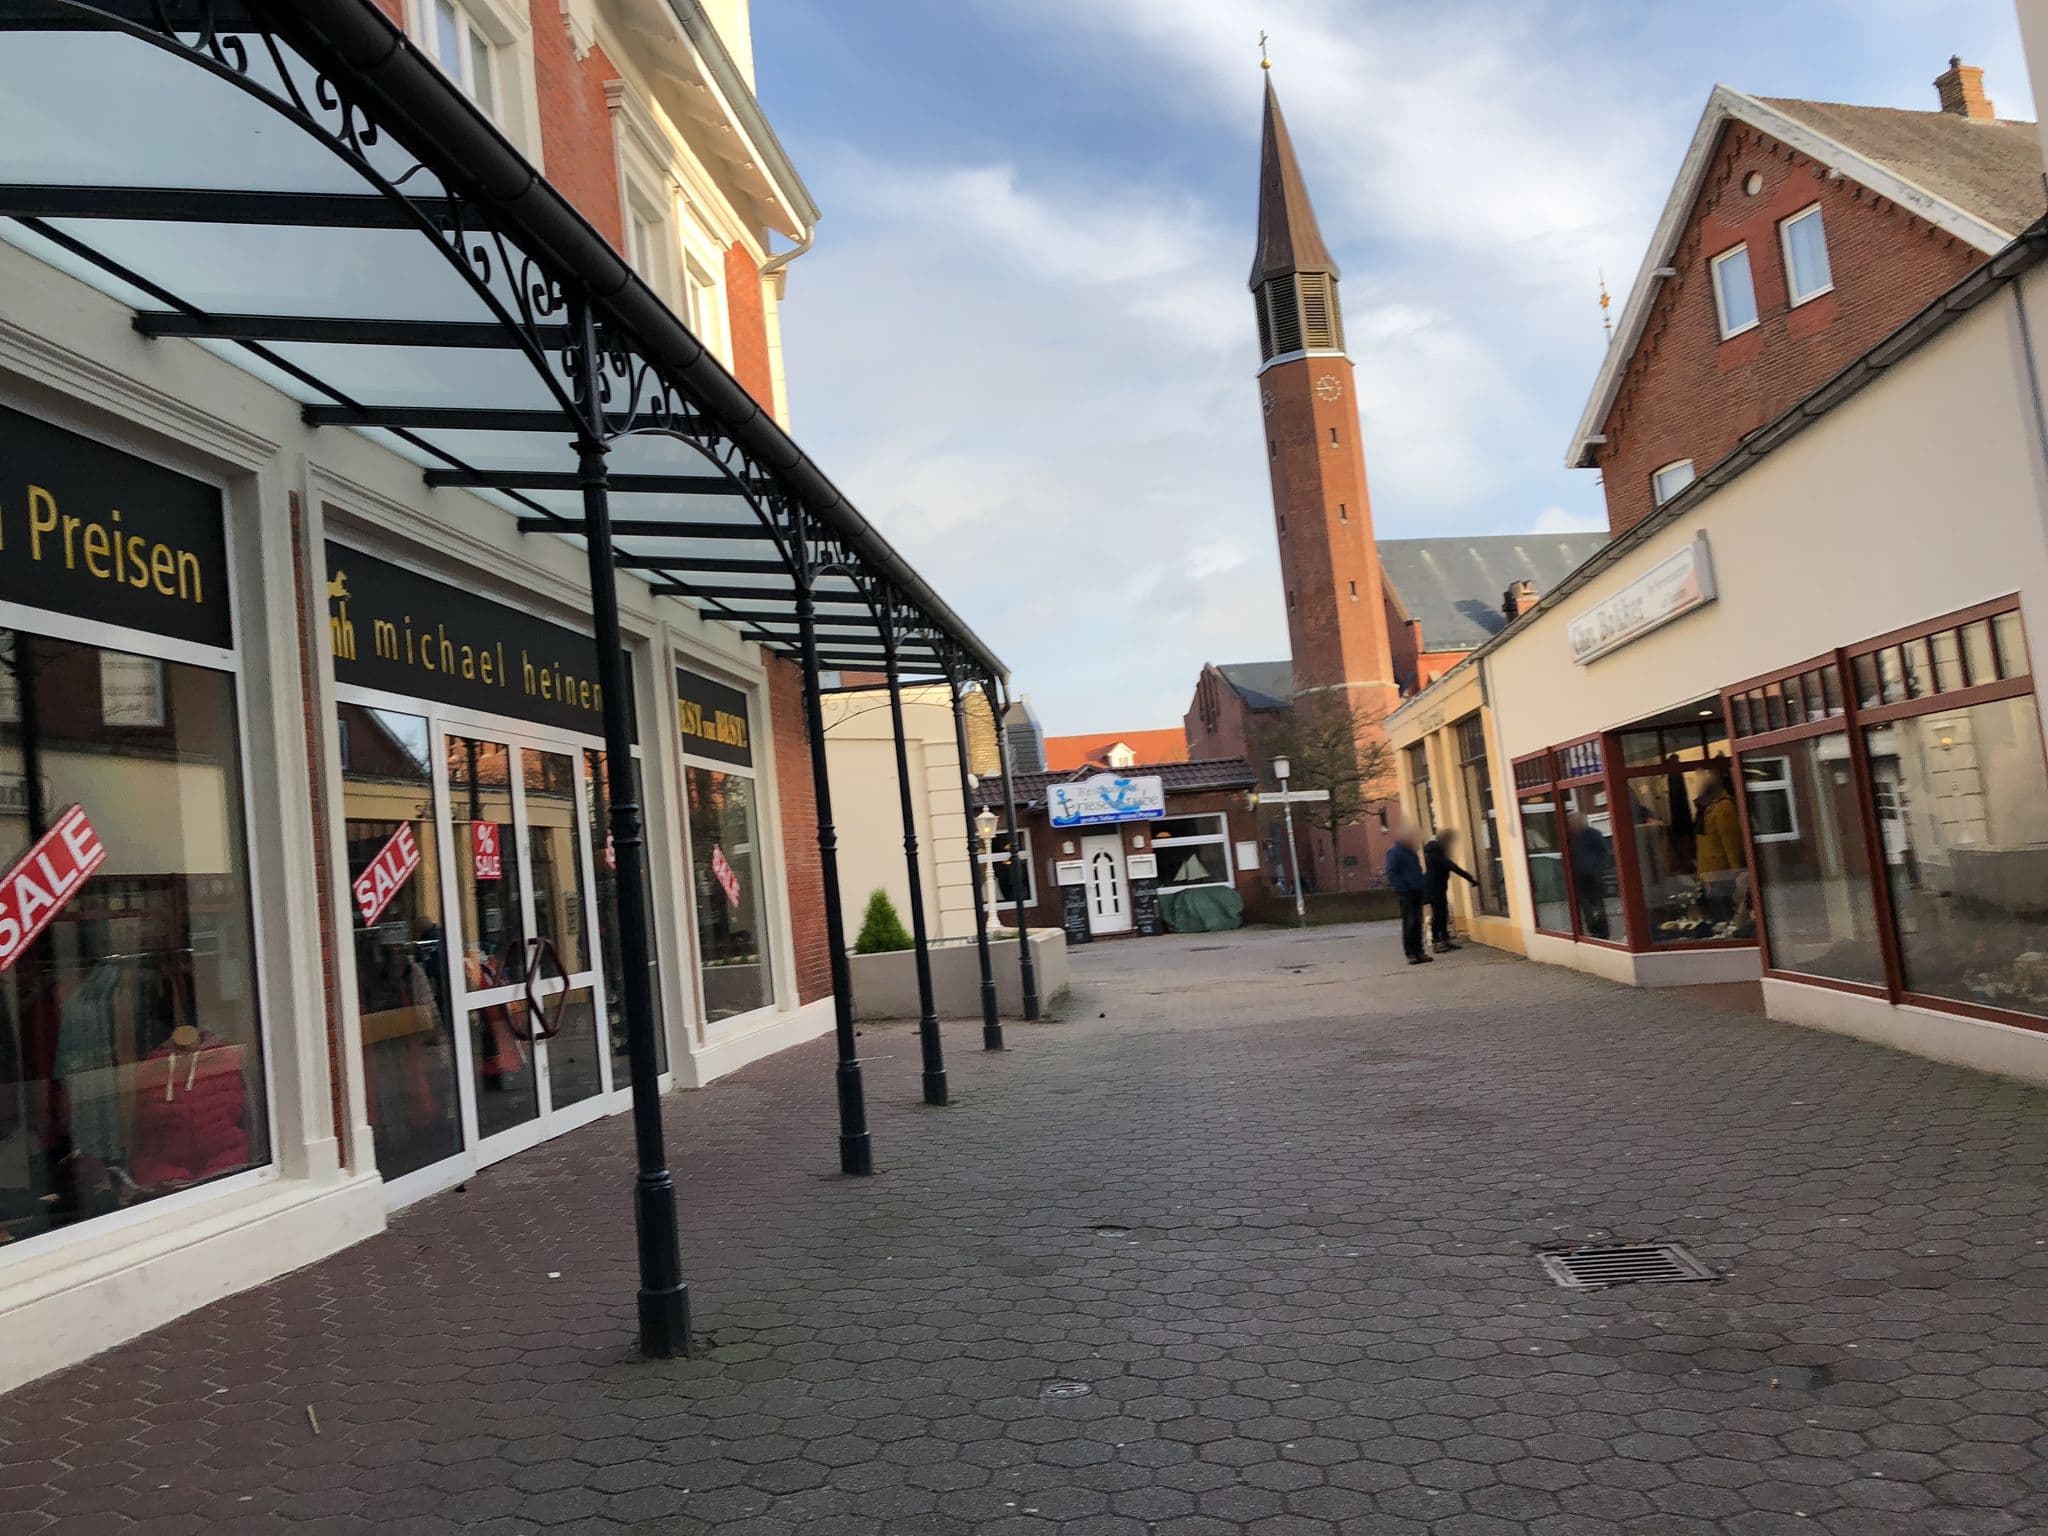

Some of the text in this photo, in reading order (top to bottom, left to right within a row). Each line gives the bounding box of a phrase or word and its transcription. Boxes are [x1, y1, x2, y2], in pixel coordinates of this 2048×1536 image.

[27, 485, 203, 603] Preisen
[373, 615, 506, 688] michael
[522, 649, 604, 711] heinen
[0, 811, 104, 958] SALE
[356, 826, 421, 918] SALE
[475, 855, 501, 876] SALE
